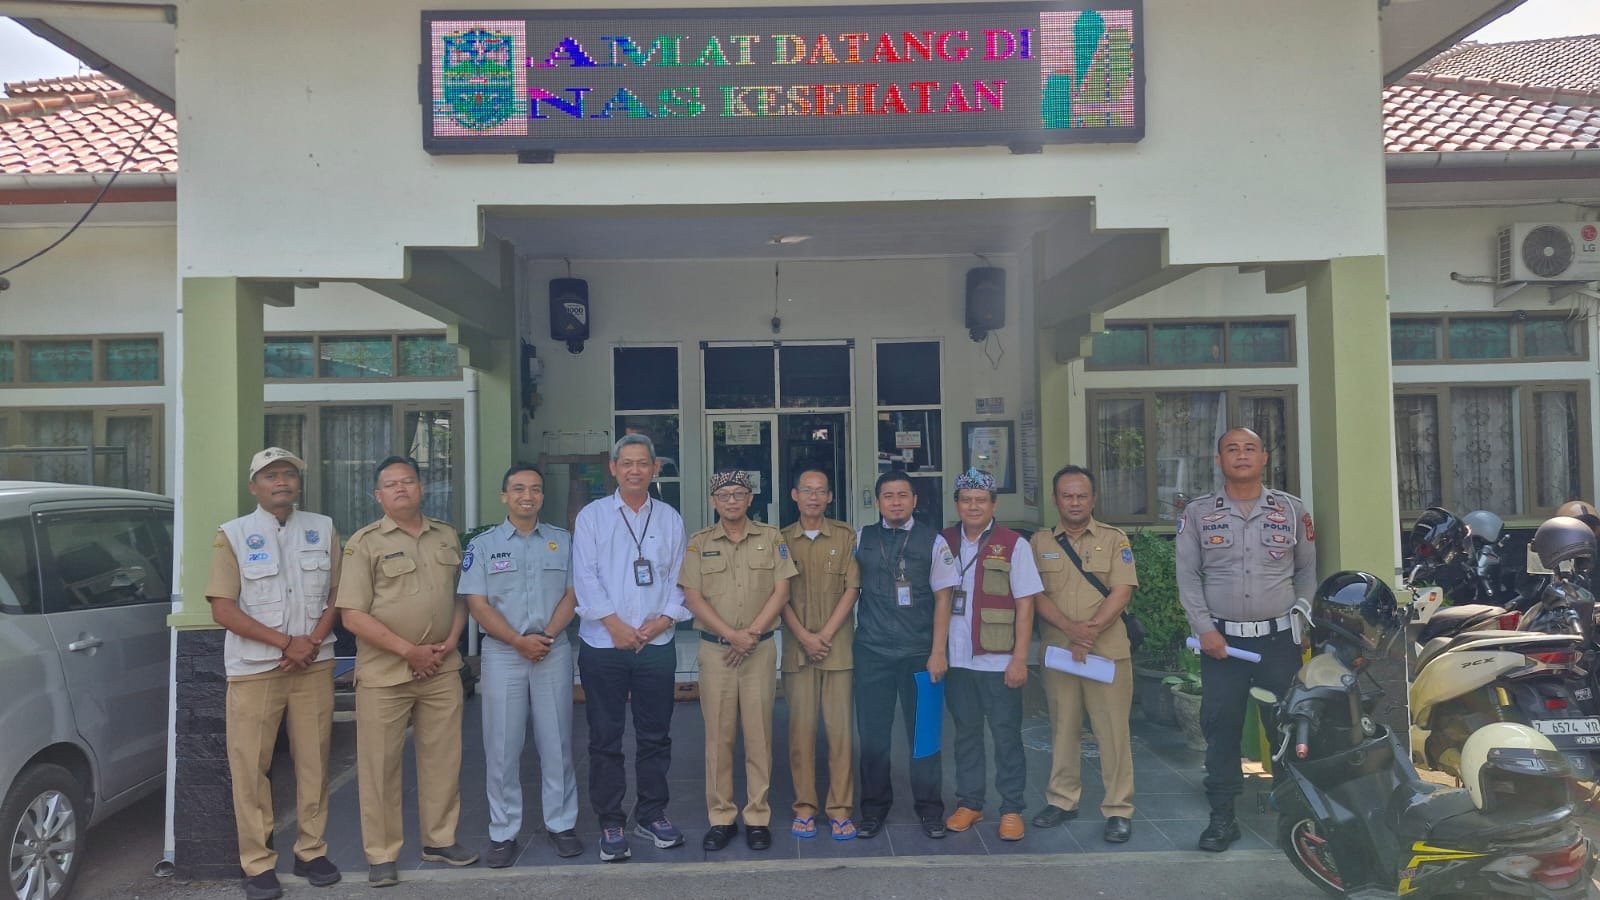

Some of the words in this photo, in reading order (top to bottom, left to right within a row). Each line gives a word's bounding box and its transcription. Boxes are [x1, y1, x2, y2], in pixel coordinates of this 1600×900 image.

[771, 29, 974, 65] DATANG
[981, 27, 1037, 62] DI
[720, 79, 1008, 118] KESEHATAN
[1583, 243, 1596, 253] LG
[490, 552, 512, 560] ARRY
[1552, 722, 1579, 734] 6574
